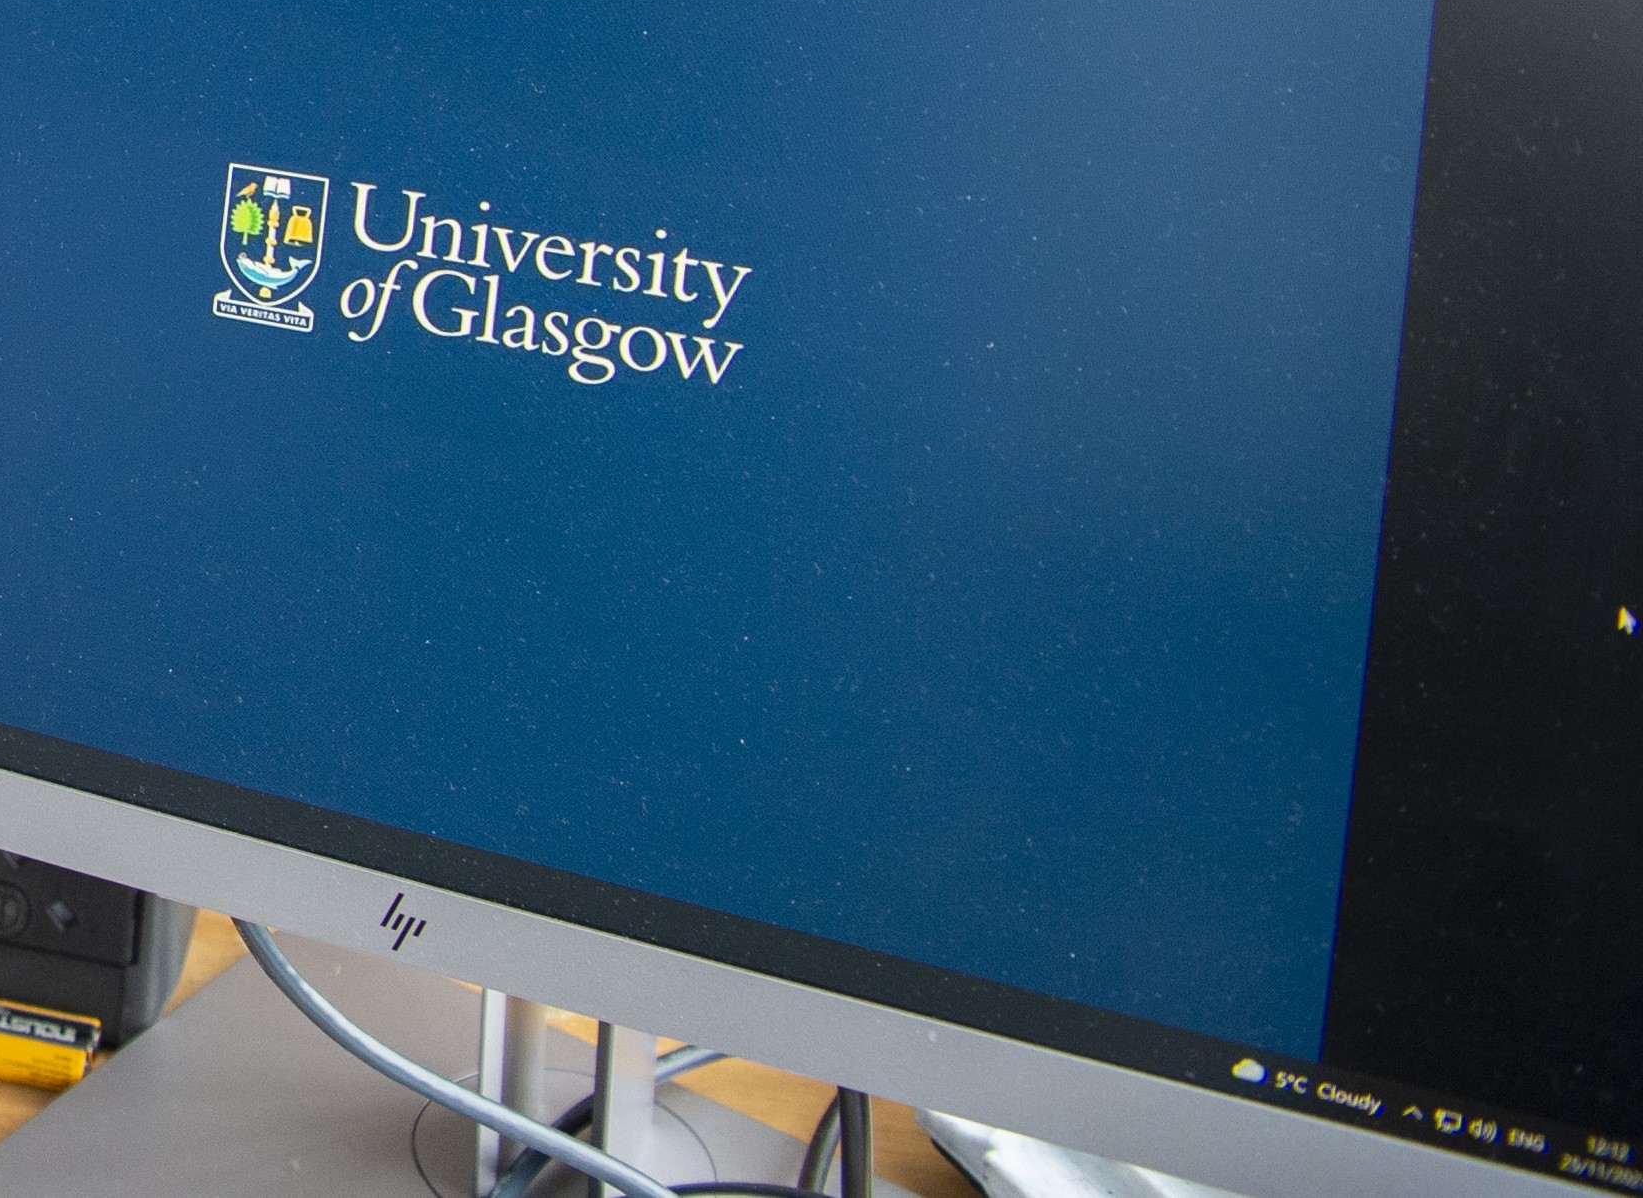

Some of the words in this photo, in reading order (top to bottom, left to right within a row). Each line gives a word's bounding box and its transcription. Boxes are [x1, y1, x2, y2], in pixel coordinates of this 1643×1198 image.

[351, 182, 752, 327] University
[220, 303, 237, 314] VIA
[240, 306, 280, 322] VERITAS
[283, 315, 307, 326] VITA
[339, 259, 419, 343] of
[413, 267, 743, 386] Glasgow
[1275, 1070, 1309, 1095] 5°C
[1317, 1081, 1382, 1116] Cloudy
[1507, 1127, 1546, 1153] ENG
